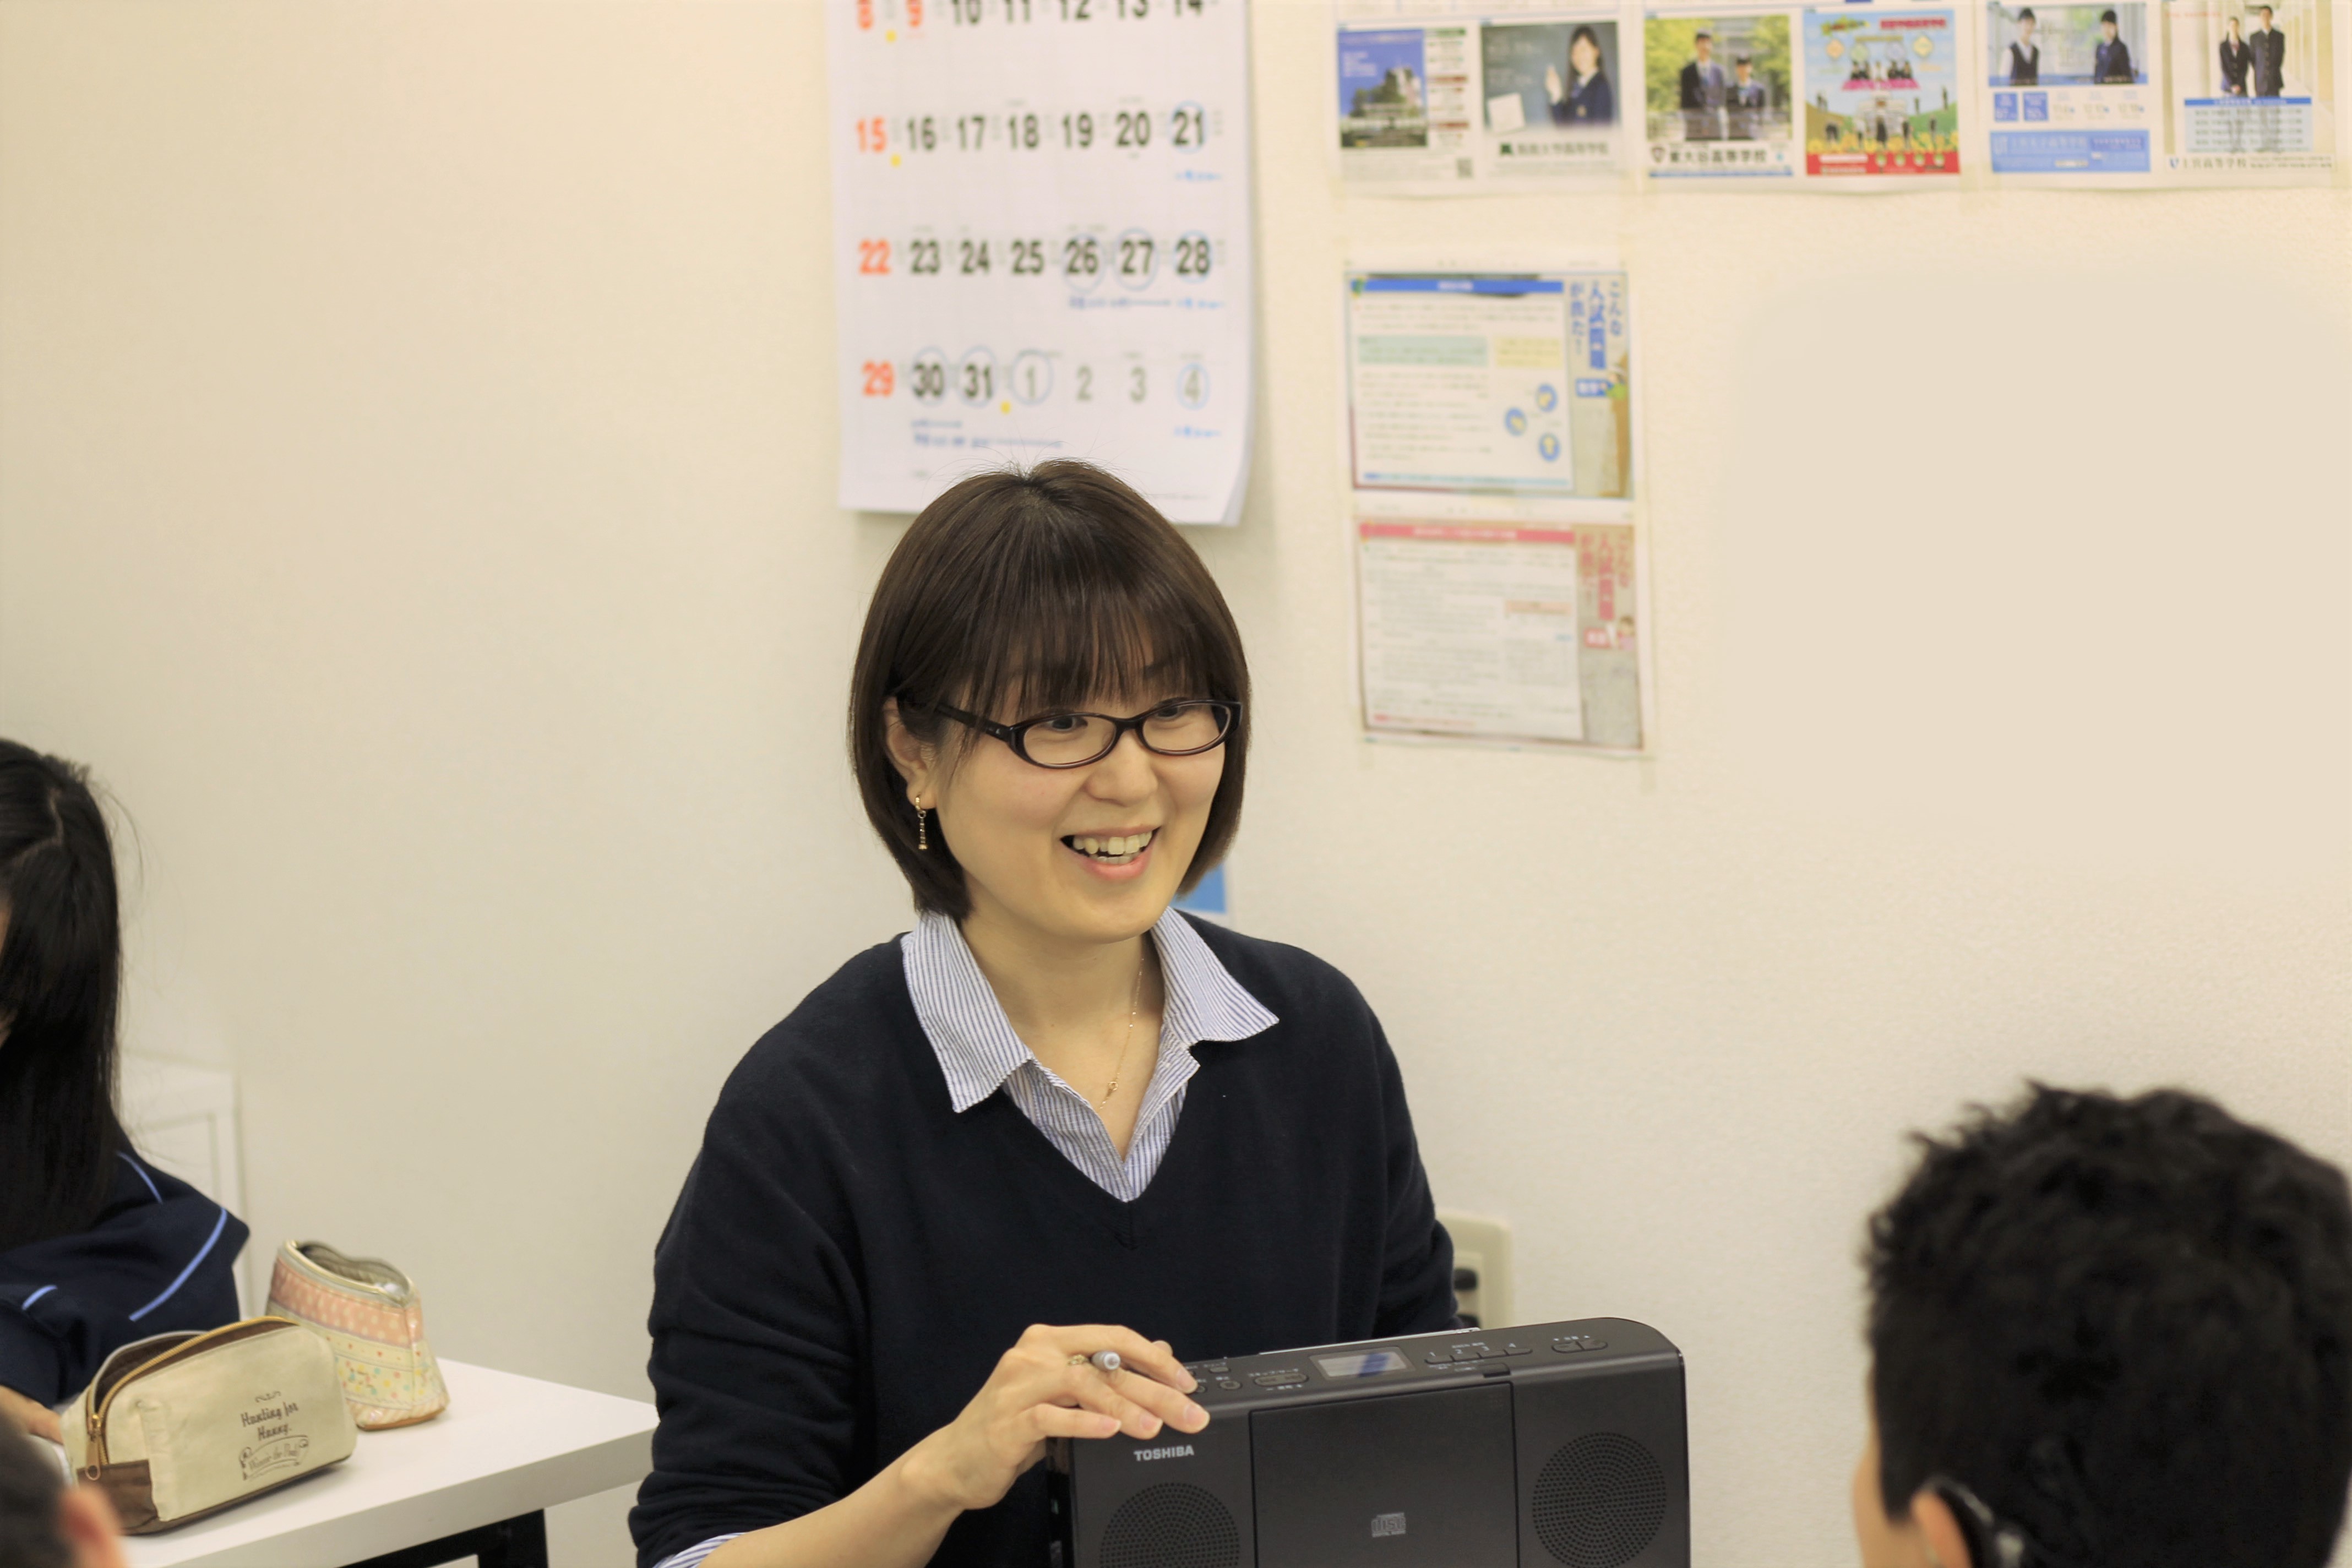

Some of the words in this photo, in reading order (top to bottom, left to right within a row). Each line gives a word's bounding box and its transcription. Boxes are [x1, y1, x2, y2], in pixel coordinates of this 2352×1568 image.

[906, 0, 923, 28] 9
[952, 0, 982, 26] 10
[1004, 0, 1032, 24] 11
[1059, 0, 1091, 21] 12
[857, 117, 887, 153] 15
[907, 116, 937, 151] 16
[957, 115, 986, 150] 17
[1009, 115, 1039, 149] 18
[1063, 113, 1093, 148] 19
[1117, 112, 1150, 147] 20
[1173, 110, 1204, 146] 21
[859, 239, 890, 275] 22
[911, 240, 940, 275] 23
[960, 240, 991, 275] 24
[1012, 239, 1044, 275] 25
[1065, 238, 1098, 275] 26
[1120, 238, 1155, 275] 27
[1176, 238, 1211, 276] 28
[863, 361, 895, 397] 29
[913, 362, 944, 399] 30
[964, 363, 993, 399] 31
[1025, 365, 1037, 399] 1
[1077, 365, 1093, 401] 2
[1130, 365, 1147, 402] 3
[1182, 365, 1202, 403] 4
[240, 1407, 282, 1428] Hunting
[282, 1401, 299, 1417] for
[1134, 1444, 1195, 1462] TOSHIBA
